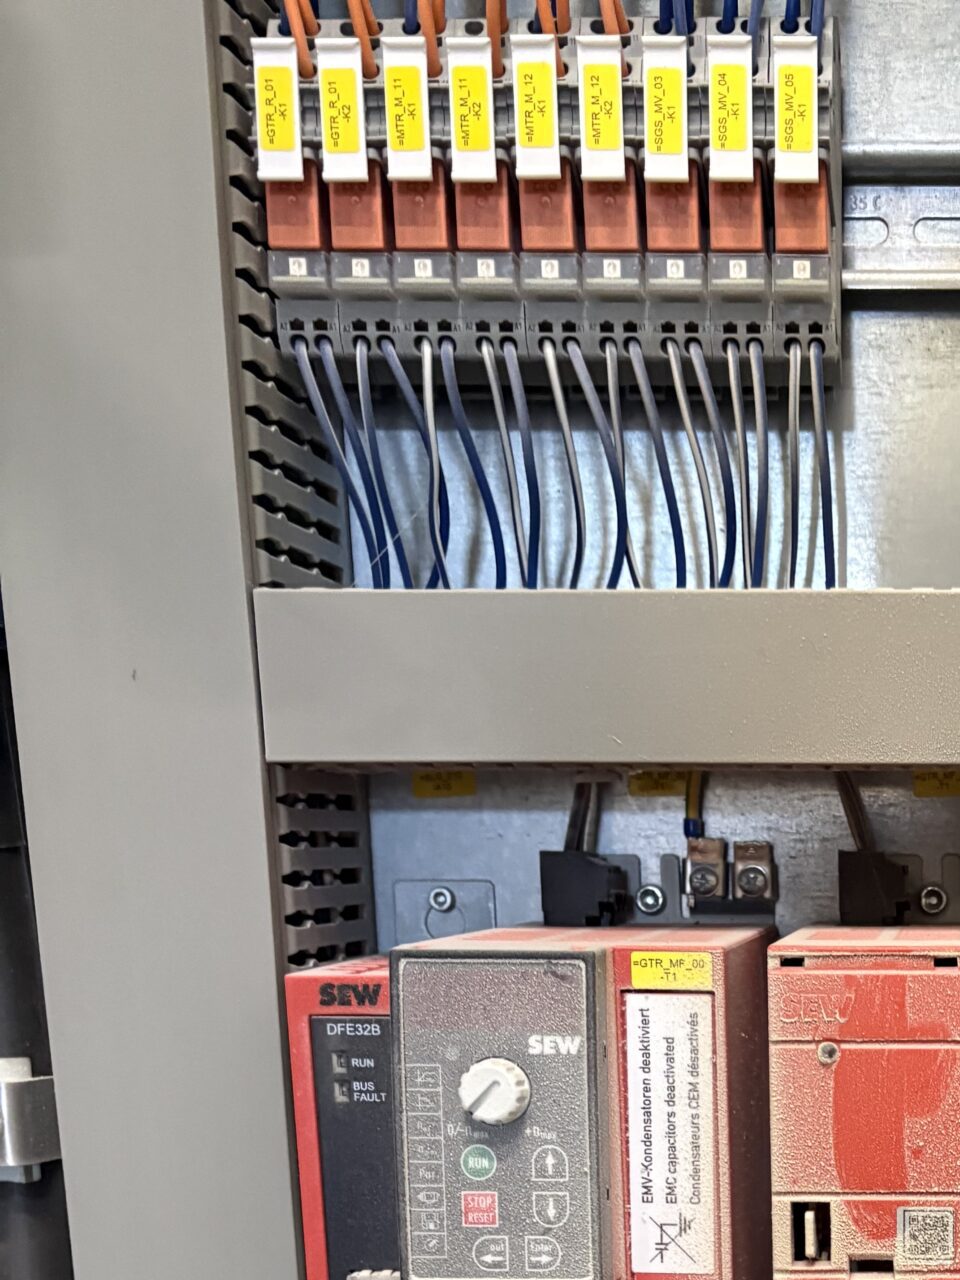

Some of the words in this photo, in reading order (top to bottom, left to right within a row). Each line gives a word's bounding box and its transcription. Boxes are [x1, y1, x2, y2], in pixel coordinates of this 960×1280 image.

[264, 78, 278, 144] =GTR_R_01
[278, 102, 288, 121] -K1
[328, 80, 342, 147] =GTR_R_01
[342, 104, 351, 123] -K2
[392, 78, 406, 146] =MTR_M_11
[407, 102, 417, 121] -K1
[458, 78, 472, 146] =MTR_M_11
[472, 102, 482, 121] -K2
[522, 73, 535, 143] =MTR_M_12
[537, 98, 546, 117] -K1
[590, 74, 603, 145] =MTR_M_12
[604, 100, 613, 120] -K2
[654, 76, 666, 152] =SGS_MV_03
[667, 105, 676, 124] -K1
[718, 72, 731, 149] =SGS_MV_04
[731, 103, 740, 121] -K1
[785, 74, 798, 150] =SGS_MV_05
[798, 103, 806, 121] -K1
[633, 958, 705, 971] =GTR_MF_00
[660, 972, 677, 981] -T1
[319, 983, 382, 1006] SEW
[780, 992, 855, 1023] SEW
[326, 1023, 381, 1036] DFE32B
[639, 1007, 652, 1074] deaktiviert
[528, 1034, 582, 1055] SEW
[687, 1012, 699, 1078] désactivés
[351, 1058, 374, 1068] RUN
[663, 1037, 676, 1107] deactivated
[353, 1081, 375, 1091] BUS
[688, 1082, 700, 1109] CEM
[353, 1093, 387, 1102] FAULT
[640, 1078, 654, 1204] EMV-Kondensatoren
[665, 1111, 679, 1174] capacitors
[468, 1157, 490, 1169] RUN
[689, 1114, 701, 1205] Condensateurs
[665, 1176, 677, 1205] EMC
[468, 1196, 492, 1208] STOP
[468, 1212, 494, 1223] RESET
